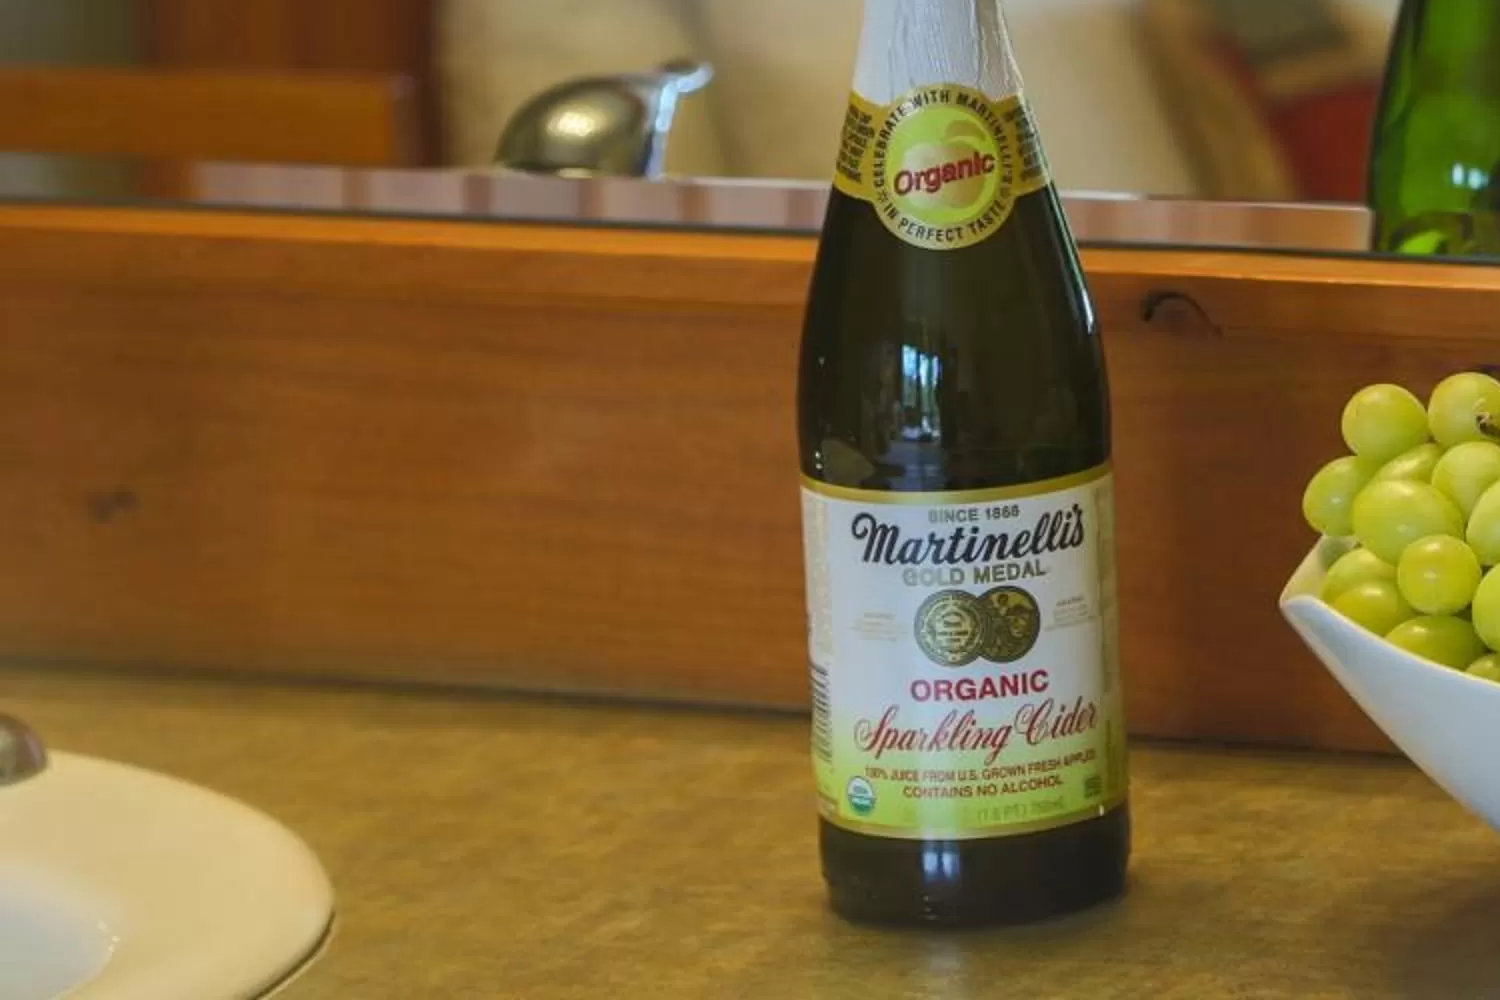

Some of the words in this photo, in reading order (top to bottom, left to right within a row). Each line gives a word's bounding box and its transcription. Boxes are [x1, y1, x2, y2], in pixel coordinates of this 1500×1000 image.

[911, 89, 950, 109] WITH
[893, 151, 997, 196] Organic
[883, 202, 899, 219] IN
[898, 217, 964, 242] PERFECT
[928, 508, 979, 523] SINCE
[851, 503, 1084, 566] Martinelli's
[902, 567, 965, 586] GOLD
[973, 560, 1048, 584] MEDAL
[911, 670, 1049, 701] ORGANIC
[854, 704, 1012, 765] Sparkling
[1014, 695, 1099, 745] Cider
[891, 769, 919, 781] JUICE
[922, 769, 956, 782] FROM
[982, 764, 1026, 780] GROWN
[1028, 758, 1061, 774] FRESH
[902, 785, 973, 798] CONTAINS
[976, 784, 998, 797] NO
[1001, 775, 1063, 794] ALCOHOL
